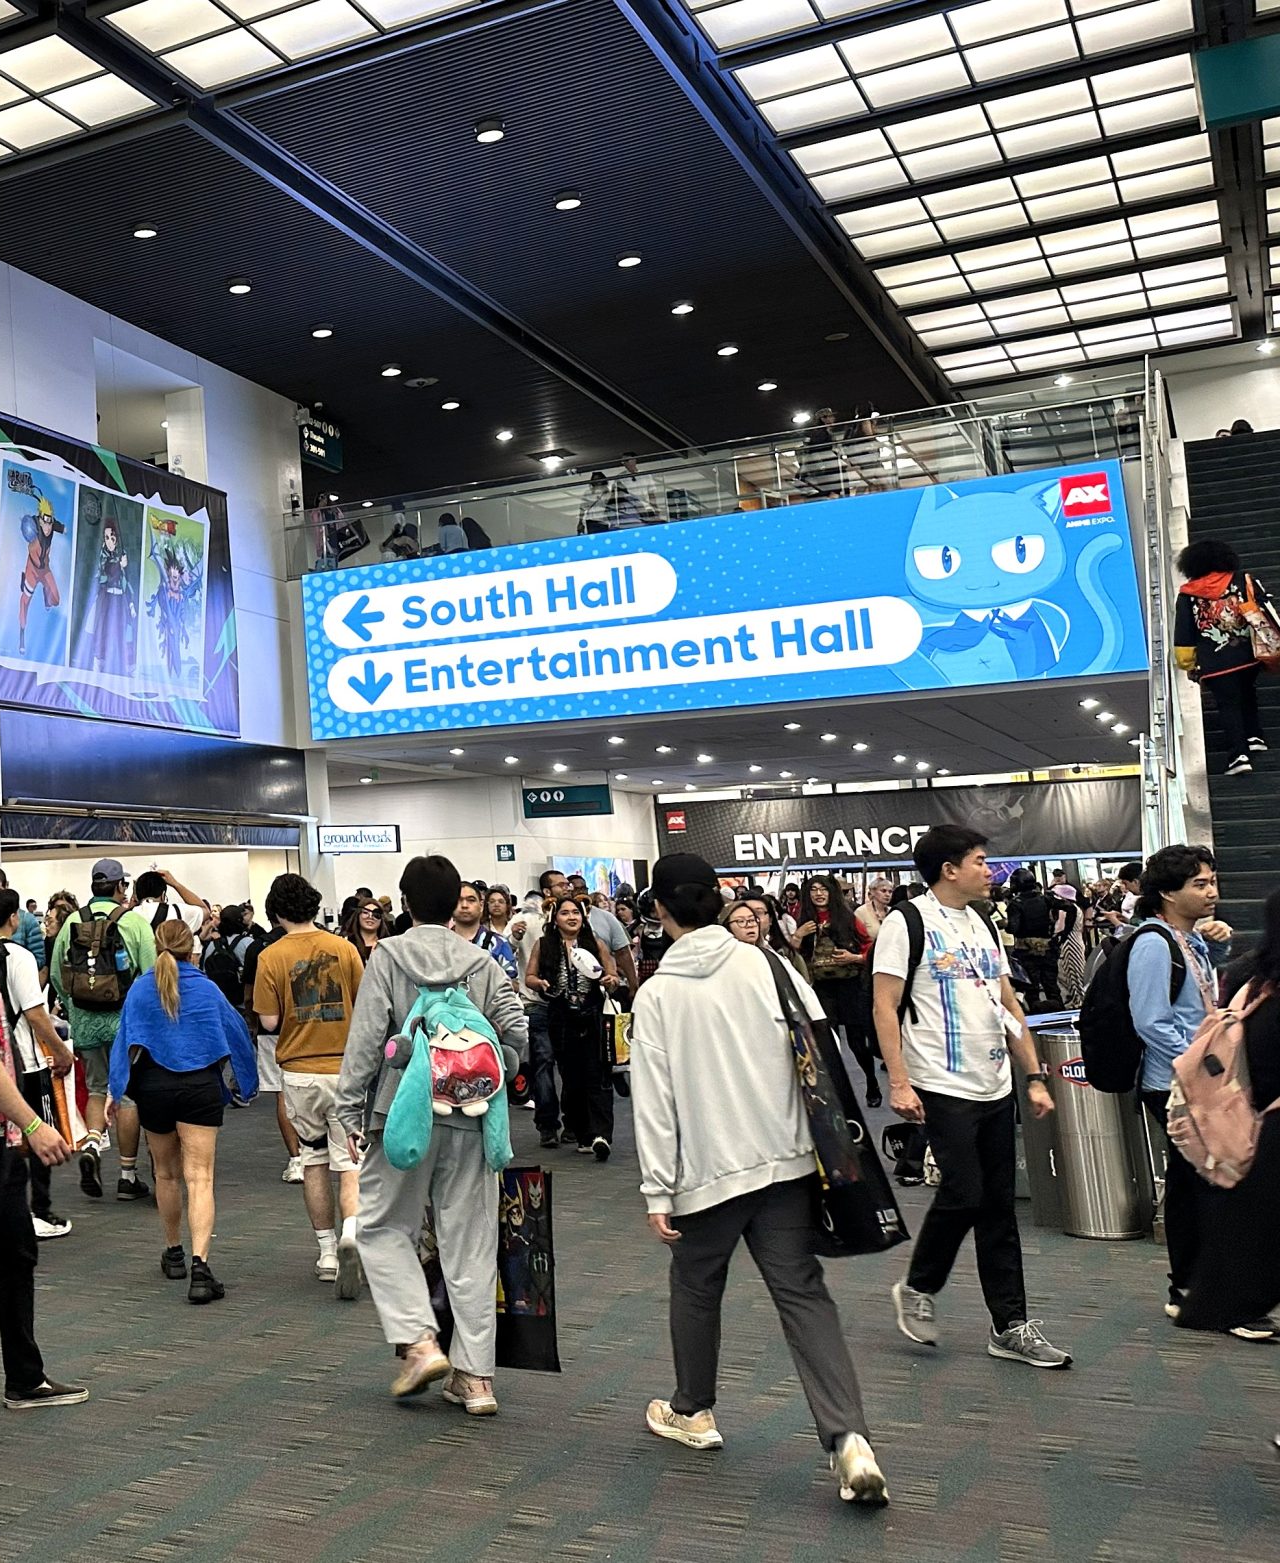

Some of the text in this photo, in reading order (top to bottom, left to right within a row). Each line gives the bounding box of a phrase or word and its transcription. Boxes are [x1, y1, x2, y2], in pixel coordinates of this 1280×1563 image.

[1064, 483, 1109, 506] AX
[402, 565, 636, 629] South Hall
[404, 607, 874, 694] Entertainment Hall
[668, 816, 686, 825] AX
